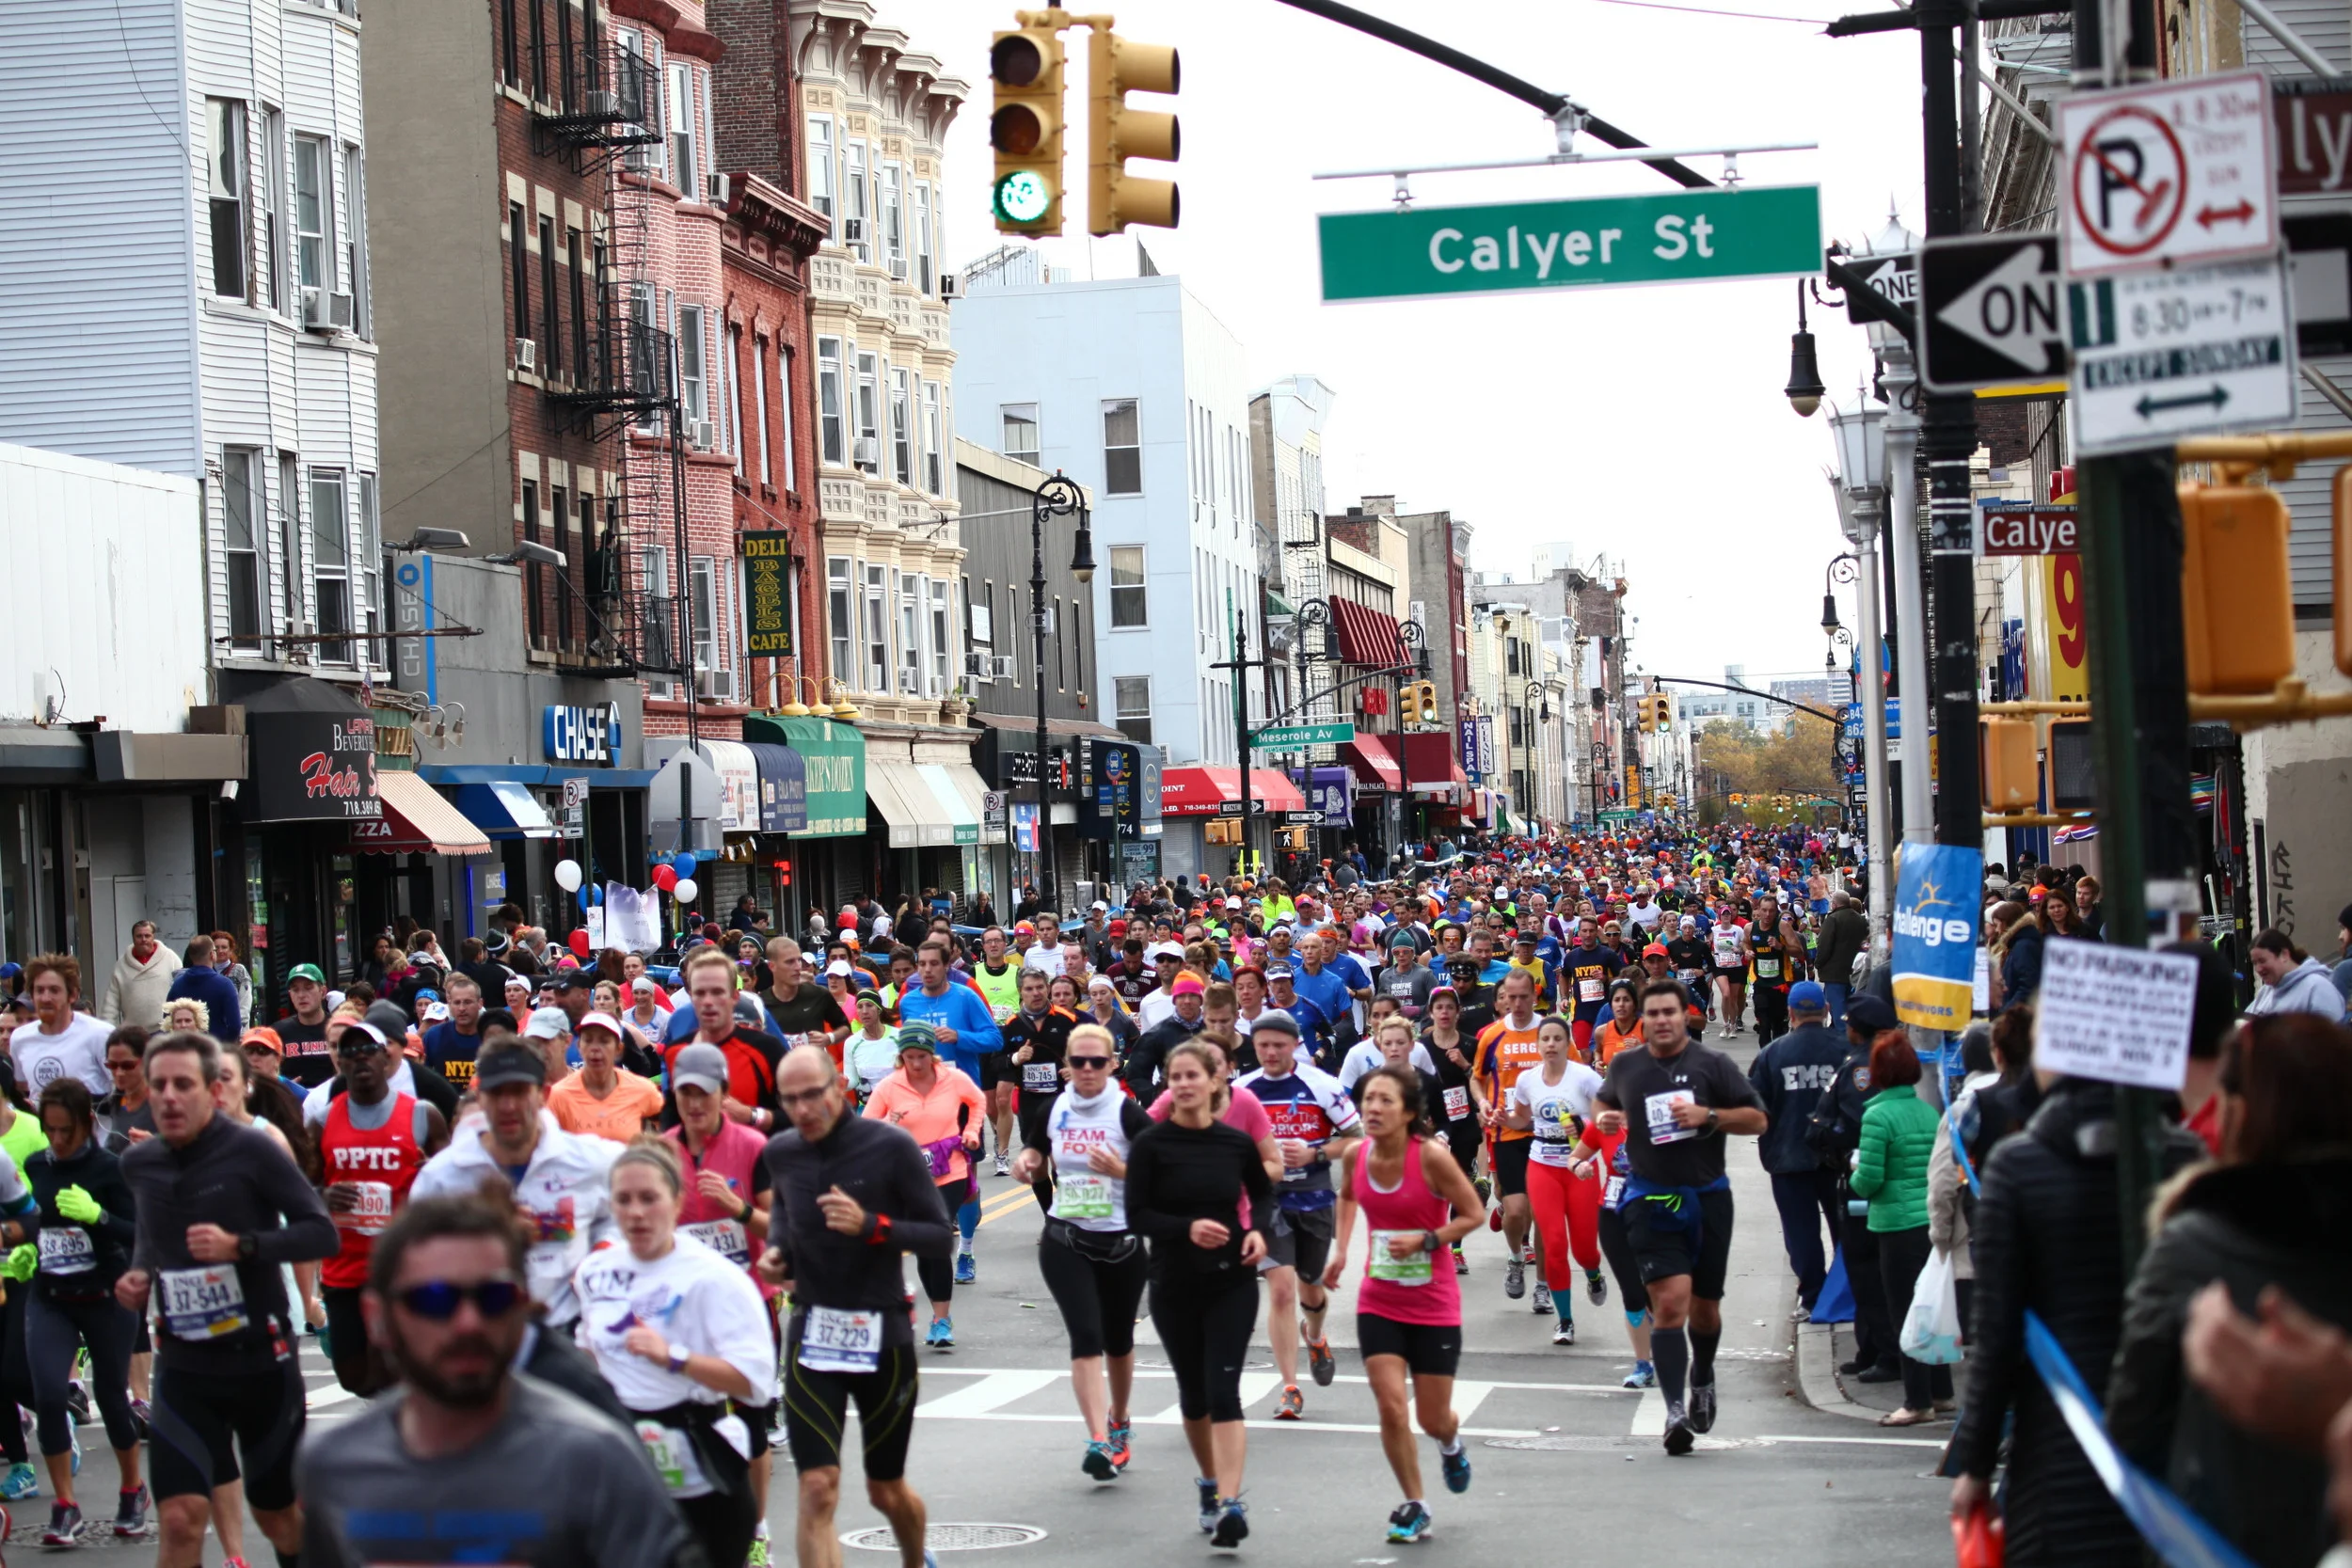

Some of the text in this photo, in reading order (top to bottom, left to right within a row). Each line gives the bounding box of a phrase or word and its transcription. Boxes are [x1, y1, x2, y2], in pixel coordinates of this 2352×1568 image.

[1429, 214, 1714, 279] Calyer St
[1986, 514, 2077, 555] Calye
[745, 539, 787, 556] DELI
[754, 560, 782, 630] BAGELS
[402, 590, 421, 677] CHASE
[750, 633, 789, 651] CAFE
[553, 705, 608, 761] CHASE
[1258, 729, 1333, 744] Meserole Av
[300, 752, 361, 799] Hair
[803, 755, 854, 793] AKER'S DOZEN
[354, 821, 392, 837] ZZA
[1142, 844, 1154, 855] 99
[1893, 903, 1971, 947] hallenge
[1438, 972, 1451, 982] ITA
[285, 1042, 300, 1057] R
[1026, 1070, 1053, 1082] 40-745
[1781, 1064, 1836, 1091] EMS
[1276, 1112, 1319, 1123] For The
[1060, 1129, 1105, 1142] TEAM
[333, 1146, 401, 1171] PPTC
[173, 1283, 231, 1312] 37-544
[815, 1323, 870, 1349] 37-229
